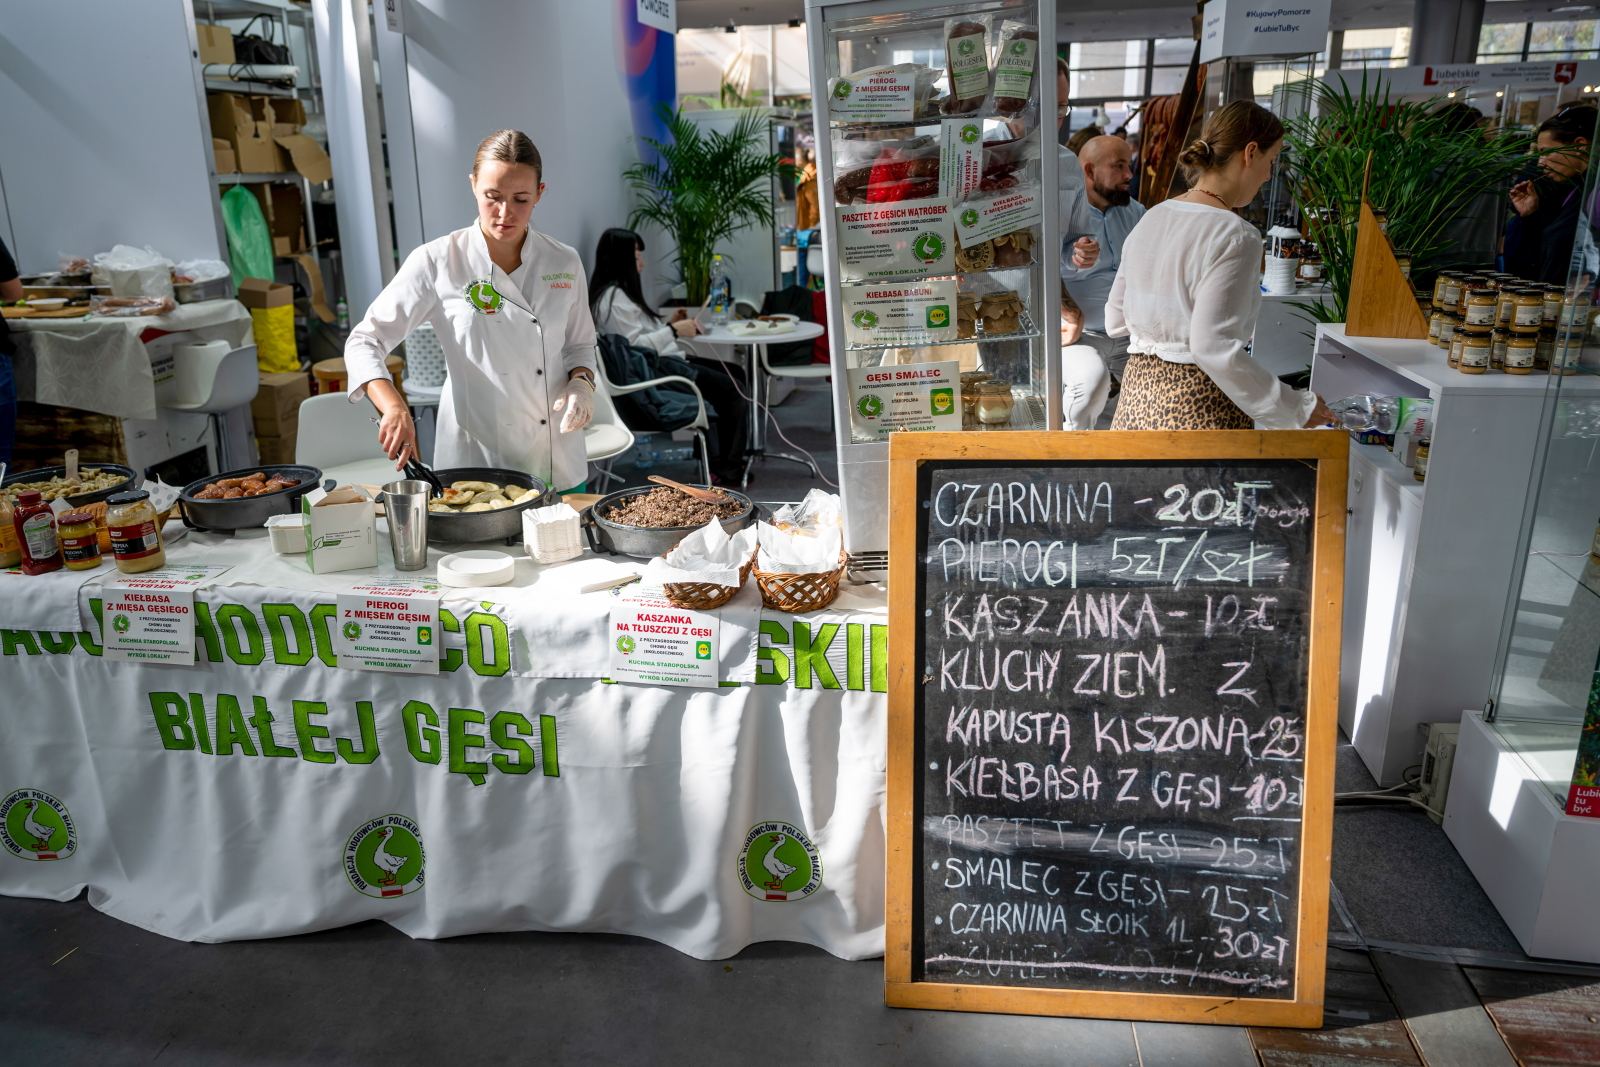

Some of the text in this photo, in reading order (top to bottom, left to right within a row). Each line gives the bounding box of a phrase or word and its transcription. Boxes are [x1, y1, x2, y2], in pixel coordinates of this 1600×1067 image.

[1246, 9, 1311, 19] #KujawyPomorze
[1254, 25, 1300, 33] #LubieTuByc
[888, 85, 910, 93] GĘSIM
[993, 194, 1023, 207] KIEŁBASA
[842, 204, 948, 223] PASZTET Z GĘSICH WĄTRÓBEK
[989, 203, 1014, 215] MIĘSEM
[895, 267, 929, 275] LOKALNY
[866, 288, 933, 299] KIEŁBASA BABUNI
[866, 369, 941, 383] GĘSI SMALEC
[935, 481, 1113, 527] CZARNINA
[938, 537, 1078, 588] PIEROGI
[124, 593, 171, 603] KIEŁBASA
[106, 603, 189, 614] Z MIĘSA GĘSIEGO
[366, 600, 409, 611] PIEROGI
[344, 610, 431, 624] Z MIĘSEM GĘSIM
[637, 613, 692, 625] KASZANKA
[616, 623, 712, 639] NA TŁUSZCZU Z GĘSI
[143, 638, 179, 646] STAROPOLSKA
[628, 659, 700, 670] KUCHNIA STAROPOLSKA
[940, 646, 1062, 694] KLUCHY
[1073, 643, 1177, 698] ZIEM.
[662, 675, 689, 683] LOKALNY
[148, 691, 560, 787] BIAŁEJ GĘSI
[945, 704, 1072, 763] KAPUSTĄ
[945, 756, 1102, 802] KIEŁBASA
[1117, 768, 1140, 802] Z
[1151, 770, 1221, 812] GĘSI
[32, 791, 64, 813] POLSKIEJ
[1575, 797, 1587, 805] tu
[1573, 803, 1592, 814] być
[388, 816, 421, 838] POLSKIEJ
[348, 819, 384, 852] HODOWCÓW
[740, 822, 821, 895] FUNDACJA HODOWCÓW POLSKIEJ BIAŁEJ GĘSI
[346, 855, 368, 891] FUNDACJA
[944, 858, 1060, 896] SMALEC
[949, 902, 1068, 936] CZARNINA
[1076, 908, 1150, 938] SŁOIK
